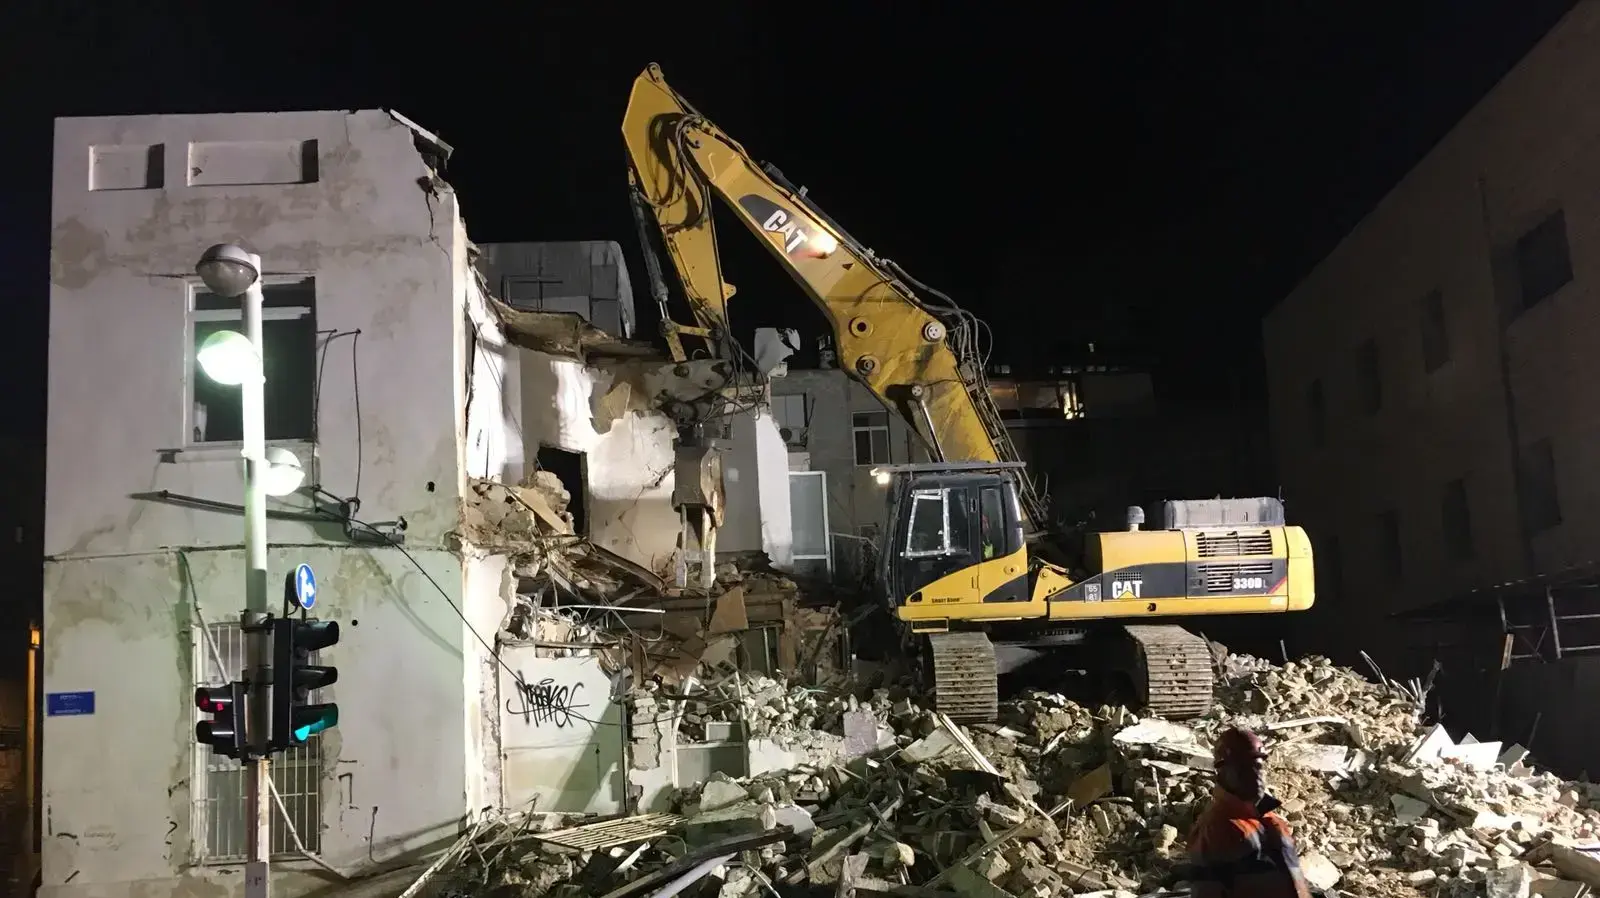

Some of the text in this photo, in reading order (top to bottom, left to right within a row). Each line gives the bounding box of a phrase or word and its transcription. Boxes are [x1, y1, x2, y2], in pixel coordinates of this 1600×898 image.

[763, 209, 808, 254] CAT
[1112, 580, 1143, 599] CAT
[1233, 577, 1262, 589] 330D
